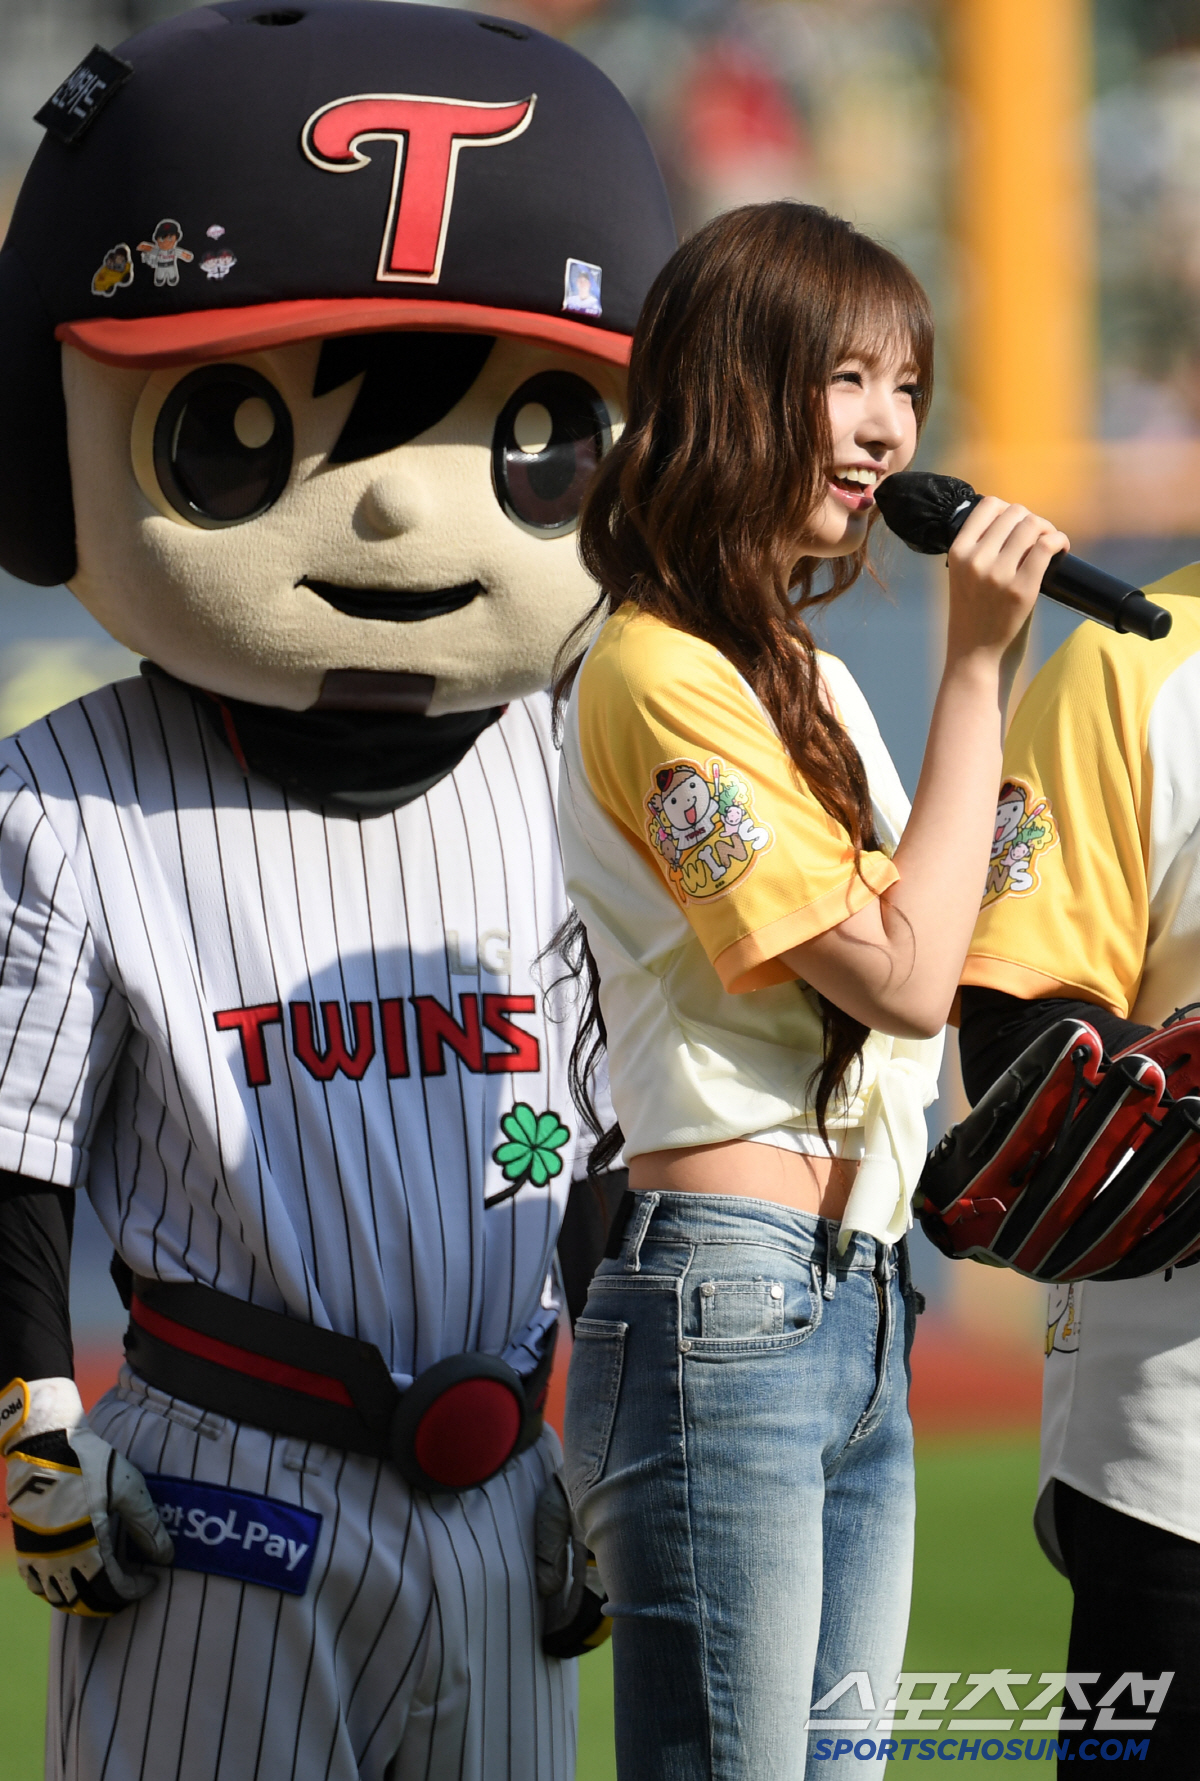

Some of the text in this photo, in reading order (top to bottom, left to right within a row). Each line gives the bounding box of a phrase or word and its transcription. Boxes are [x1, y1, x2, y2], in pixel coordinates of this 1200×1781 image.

[301, 92, 537, 285] T
[446, 929, 512, 976] LG
[213, 992, 541, 1088] TWINS
[0, 1397, 23, 1426] PRO
[158, 1502, 310, 1571] 한 SOL Pay
